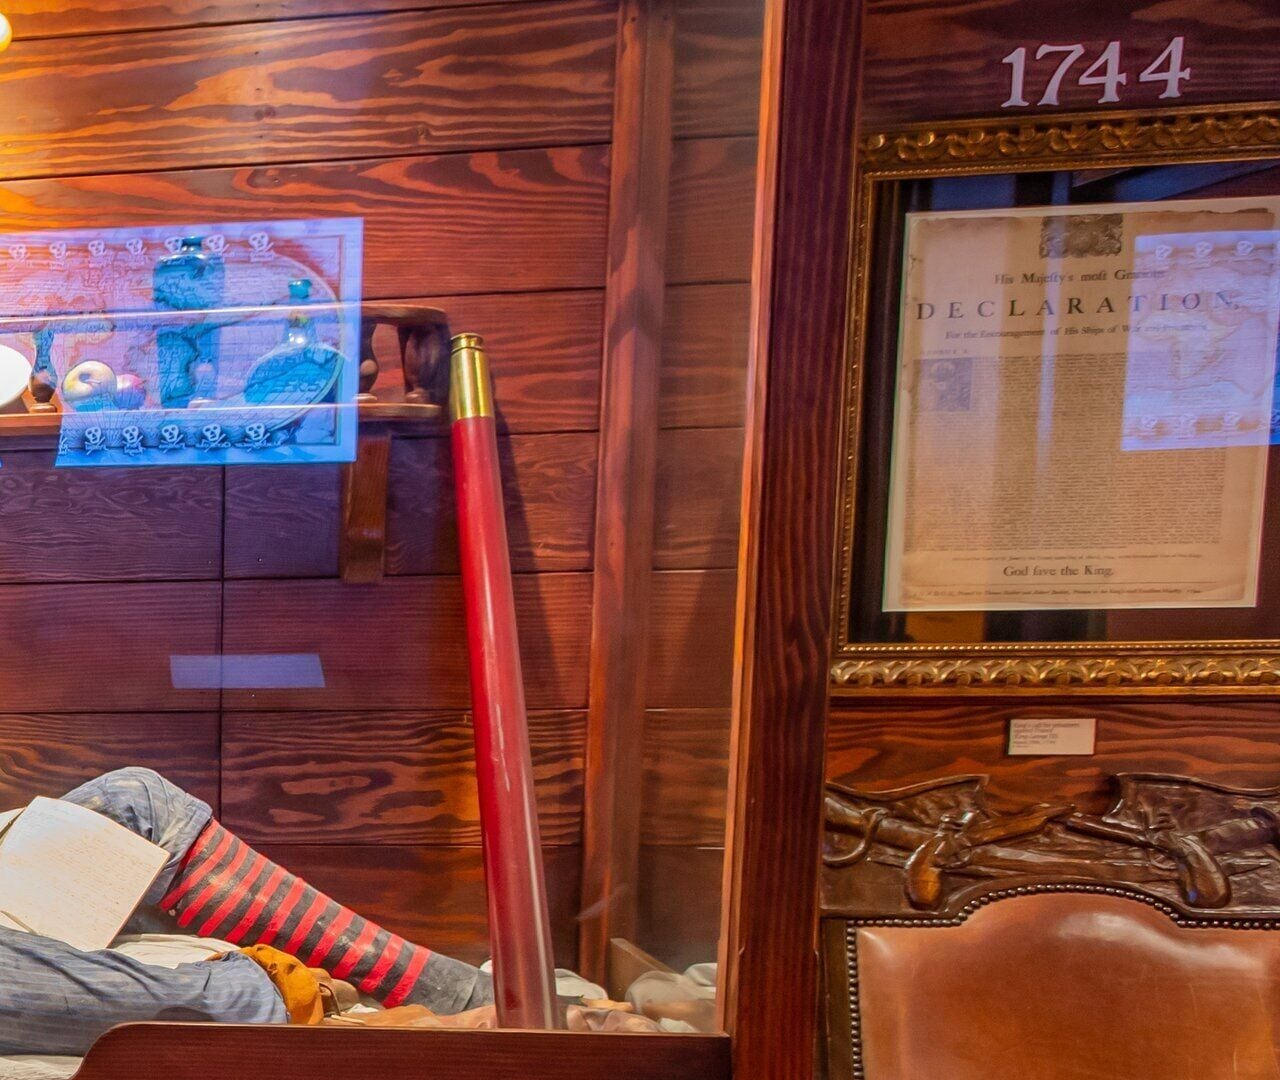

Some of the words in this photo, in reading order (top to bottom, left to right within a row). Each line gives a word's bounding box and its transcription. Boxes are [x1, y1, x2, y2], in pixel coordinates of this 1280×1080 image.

[1001, 36, 1190, 108] 1744
[1003, 565, 1028, 577] God
[1060, 564, 1078, 576] the
